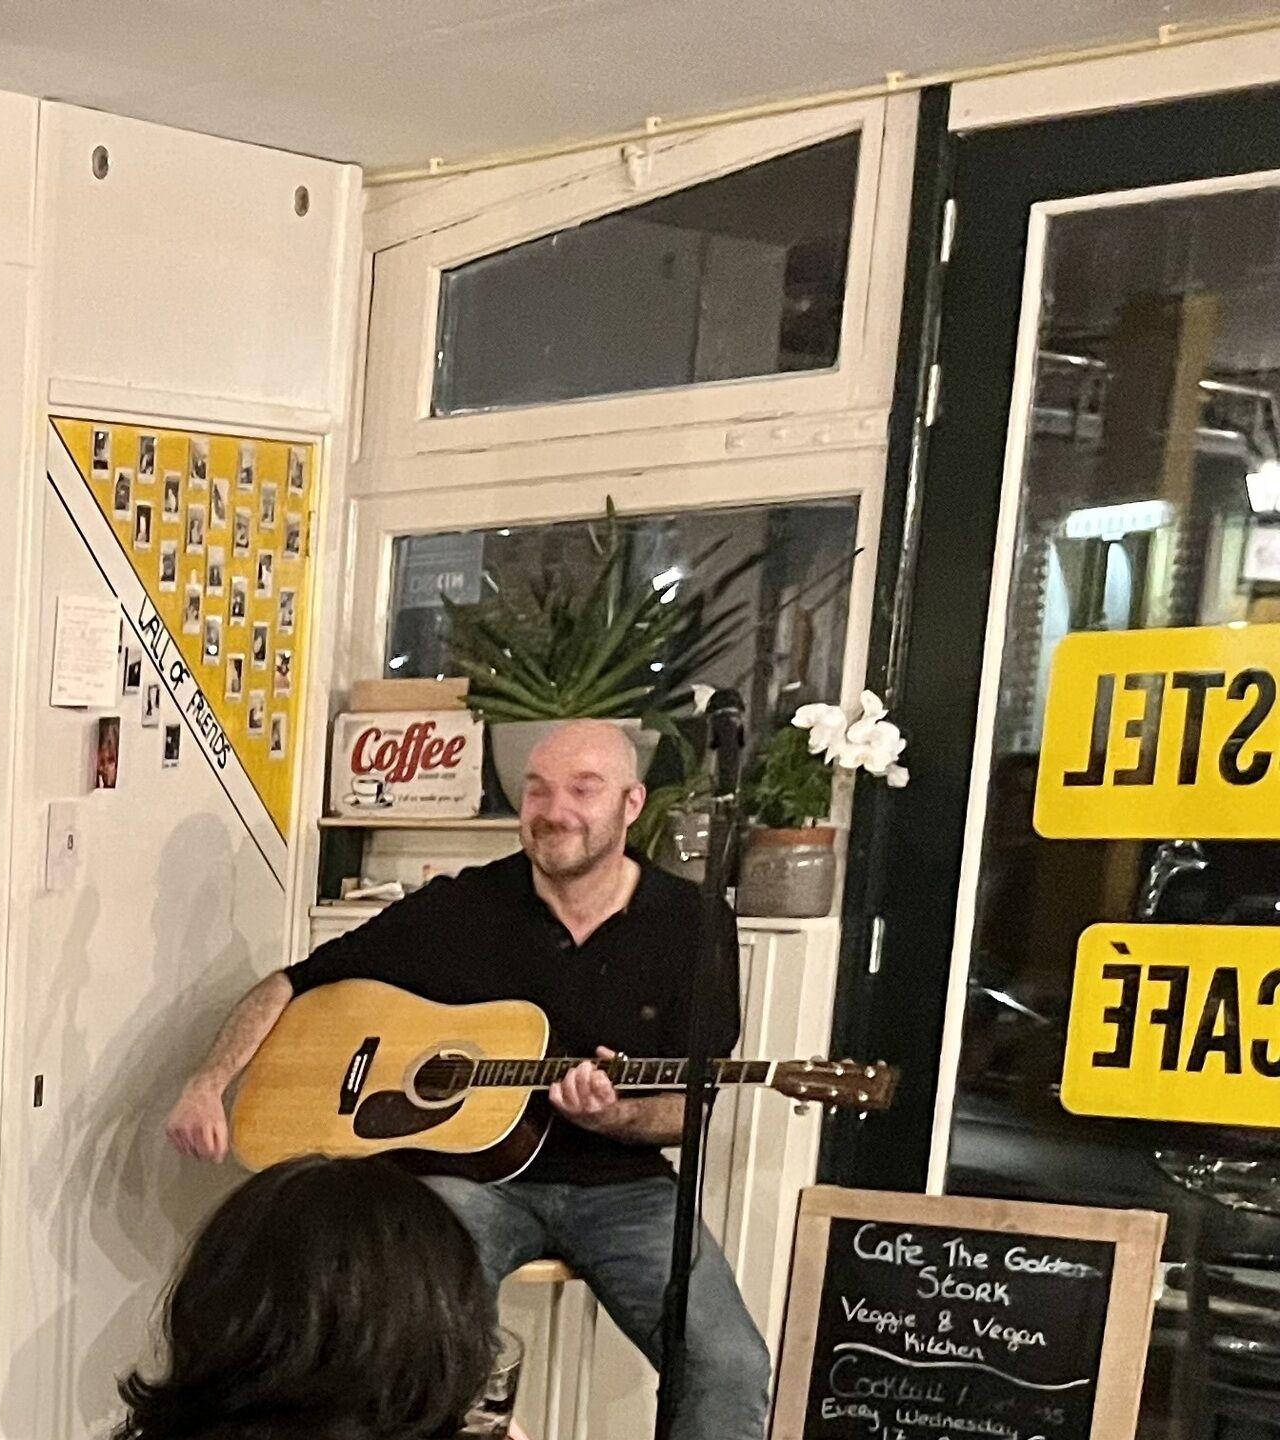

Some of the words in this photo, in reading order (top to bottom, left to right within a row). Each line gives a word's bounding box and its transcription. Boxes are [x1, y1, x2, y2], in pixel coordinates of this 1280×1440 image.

[170, 661, 190, 691] OF
[186, 688, 231, 769] FRIENDS
[351, 721, 466, 784] Coffee
[943, 1237, 989, 1270] The
[841, 1295, 917, 1334] Veggie
[938, 1310, 953, 1332] &
[973, 1318, 1047, 1352] Vegan
[905, 1331, 984, 1361] Kitchen
